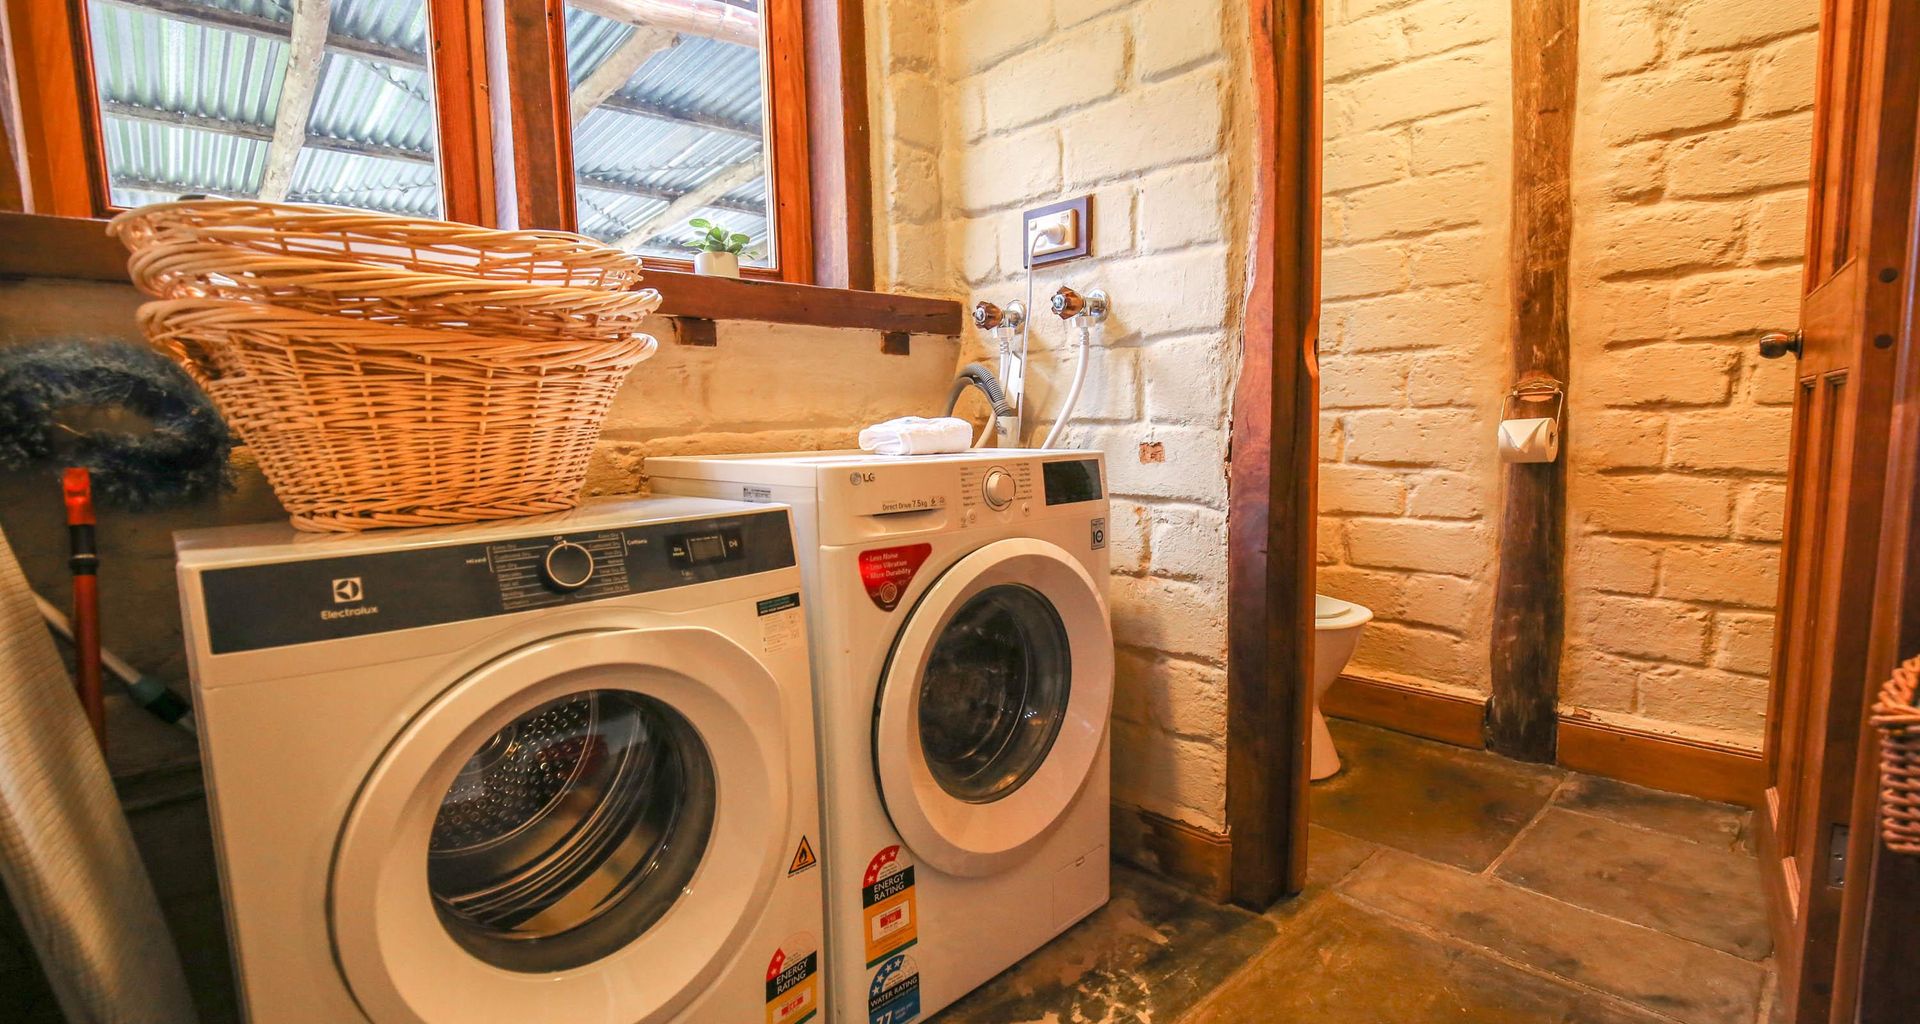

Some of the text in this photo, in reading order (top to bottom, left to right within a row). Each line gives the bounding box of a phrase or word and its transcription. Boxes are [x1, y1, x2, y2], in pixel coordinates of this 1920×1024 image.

[898, 502, 911, 510] Drive
[912, 499, 928, 508] 7.5kg
[1093, 529, 1104, 544] 10
[465, 556, 487, 564] Mixed
[883, 560, 908, 568] Vibration
[885, 568, 912, 577] Durability
[320, 605, 378, 620] Electrolux
[873, 872, 905, 893] ENERGY
[874, 881, 905, 902] RATING
[776, 958, 808, 985] ENERGY
[777, 970, 807, 995] RATING
[870, 990, 894, 1008] WATER
[894, 976, 918, 995] RATING
[876, 1010, 893, 1024] 77
